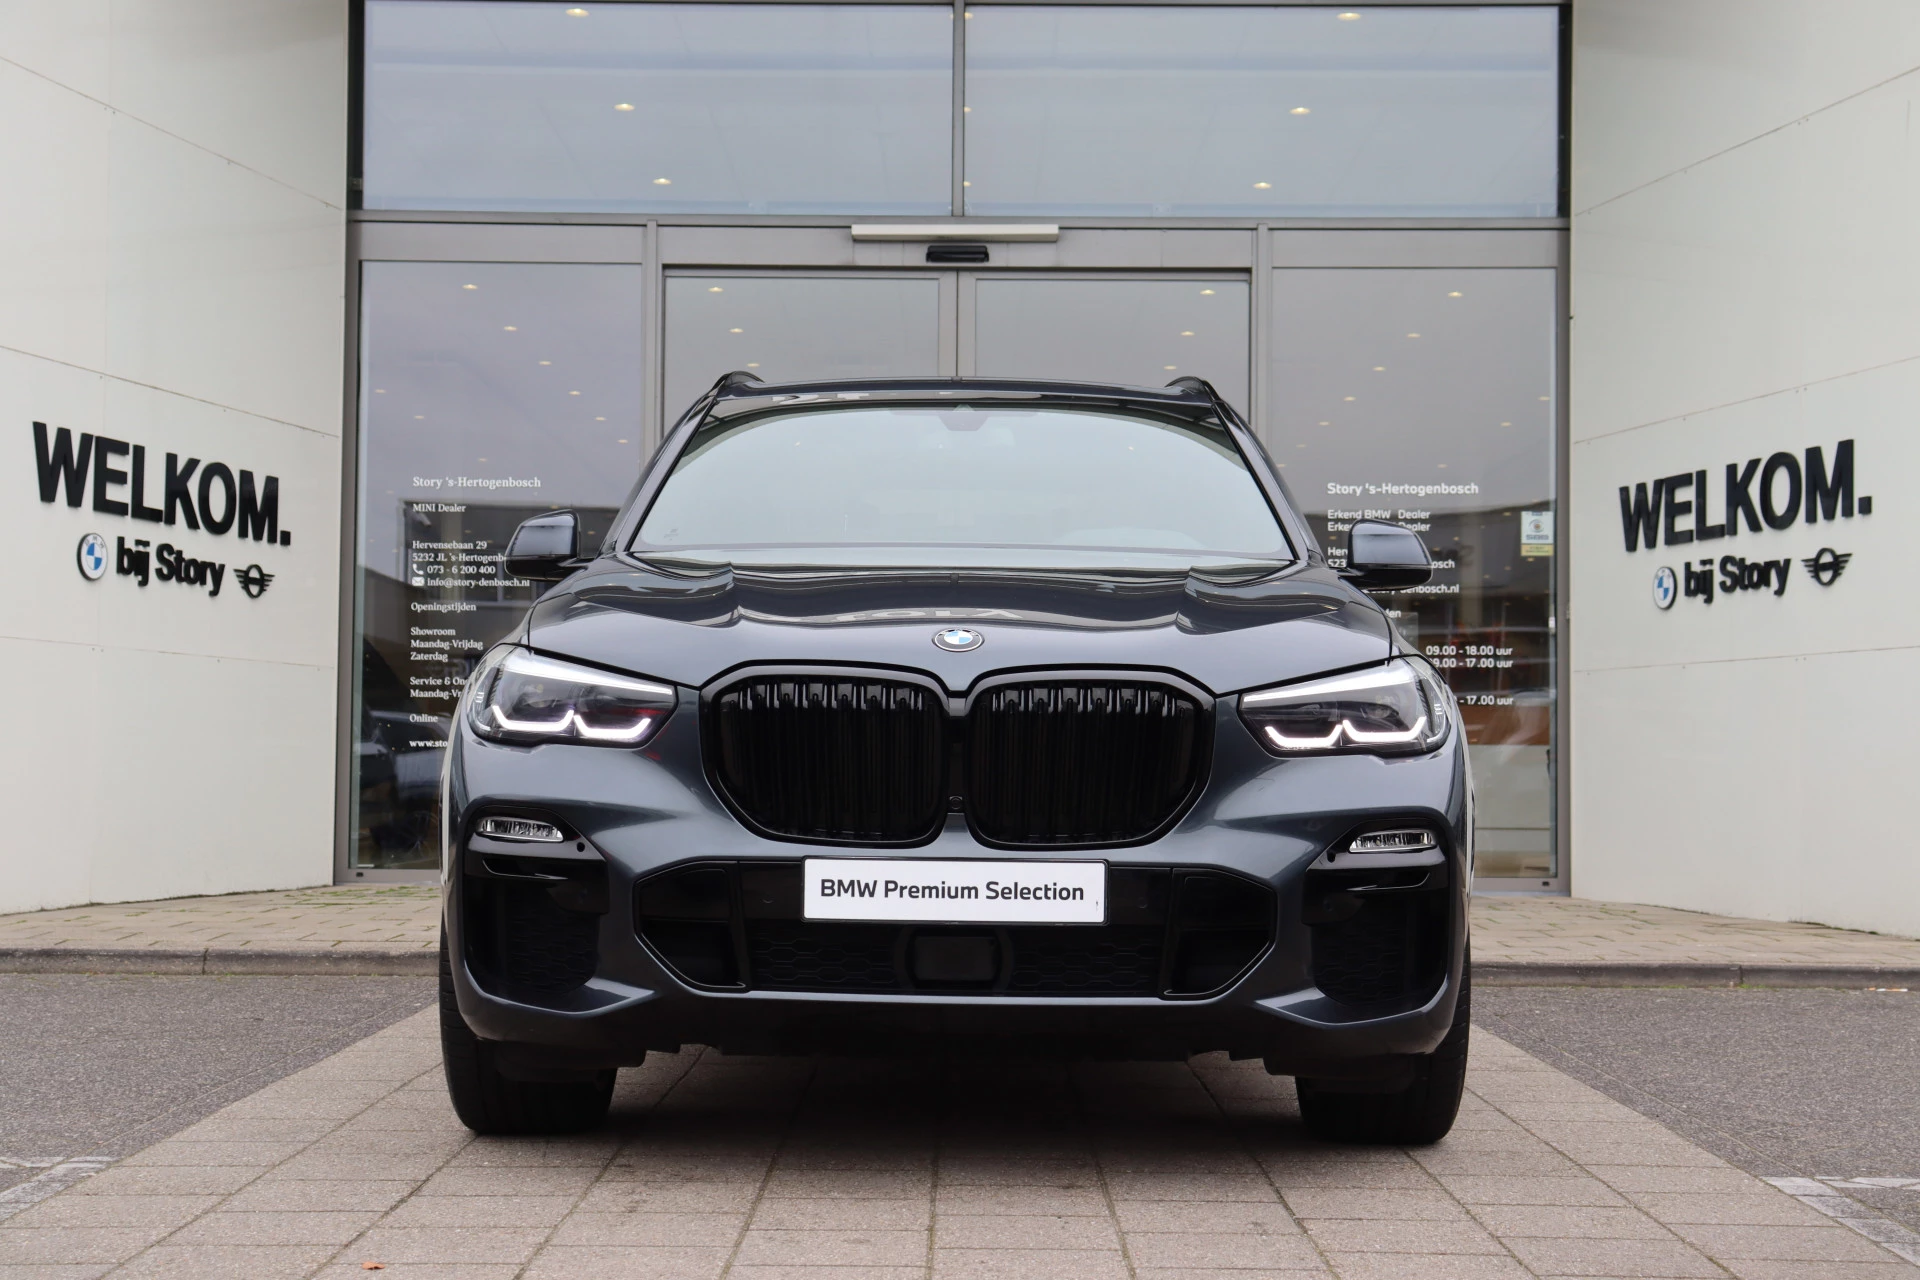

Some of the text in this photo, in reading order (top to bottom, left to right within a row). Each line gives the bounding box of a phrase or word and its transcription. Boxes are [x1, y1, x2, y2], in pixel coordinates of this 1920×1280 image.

[32, 420, 291, 546] WELKOM.
[412, 476, 443, 490] Story
[1327, 482, 1362, 496] Story
[1619, 438, 1872, 552] WELKOM.
[412, 504, 466, 512] MINI Dealer
[1328, 510, 1431, 519] Erkend BMW Dealer
[412, 541, 487, 550] Hervensebaan 29
[412, 553, 434, 562] 5232
[436, 553, 447, 562] JL
[117, 536, 225, 597] bij Story
[427, 566, 444, 574] 073
[452, 566, 457, 574] 6
[460, 566, 477, 574] 200
[478, 566, 496, 574] 400
[1684, 555, 1791, 604] bij Story
[411, 602, 476, 613] Openingstijden
[410, 627, 456, 636] Showroom
[410, 640, 483, 650] Maandag-Vrijdag
[1426, 646, 1456, 656] 09.00
[1465, 646, 1494, 656] 18.00
[1496, 647, 1513, 656] uur
[410, 652, 448, 662] Zaterdag
[1430, 658, 1456, 668] 9.00
[1496, 660, 1513, 668] uur
[410, 677, 442, 686] Service
[1497, 697, 1514, 706] uur
[410, 714, 438, 723] Online
[820, 879, 1084, 900] BMW Premium Selection
